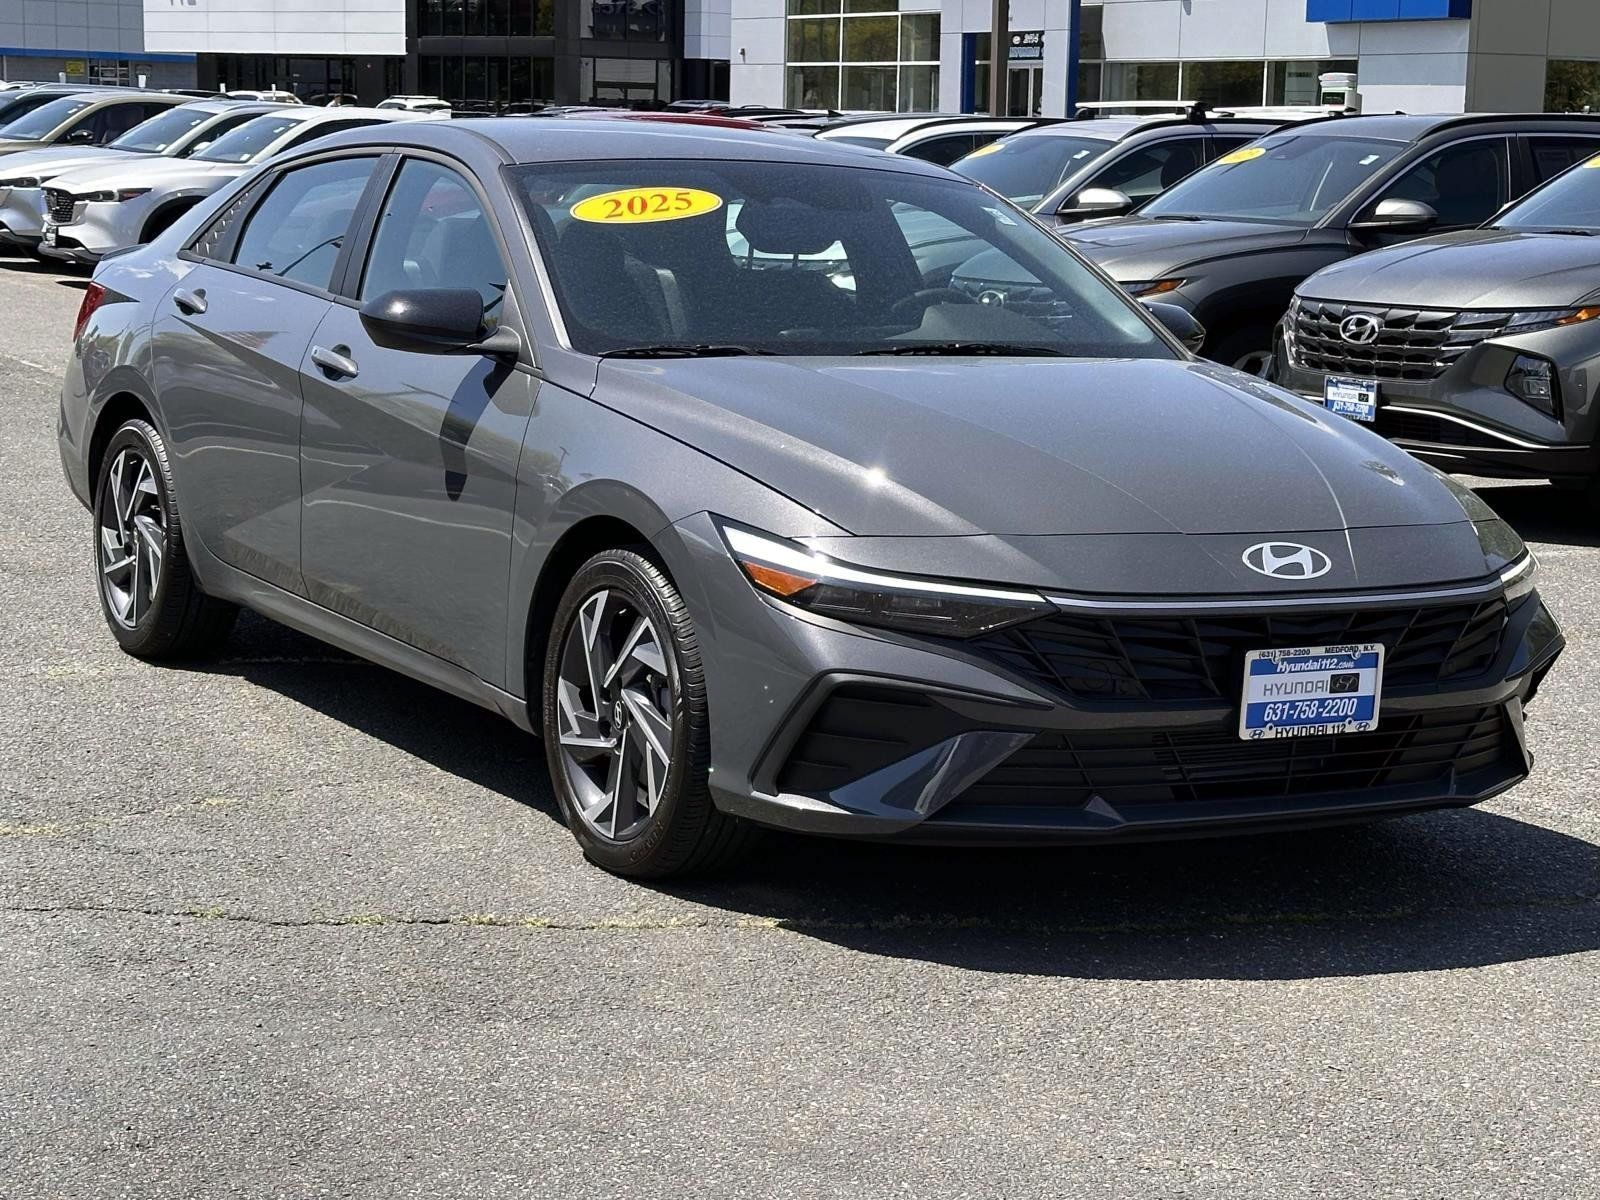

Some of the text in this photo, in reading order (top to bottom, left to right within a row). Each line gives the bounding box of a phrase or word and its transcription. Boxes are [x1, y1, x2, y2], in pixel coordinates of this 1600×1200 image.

[604, 192, 692, 219] 2025
[1278, 648, 1311, 657] 758-2200
[1324, 645, 1360, 654] MEDFORD
[1263, 680, 1329, 697] HYUNDAI
[1264, 698, 1358, 721] 631-758-2200
[1275, 723, 1347, 739] HYUNDAI 112
